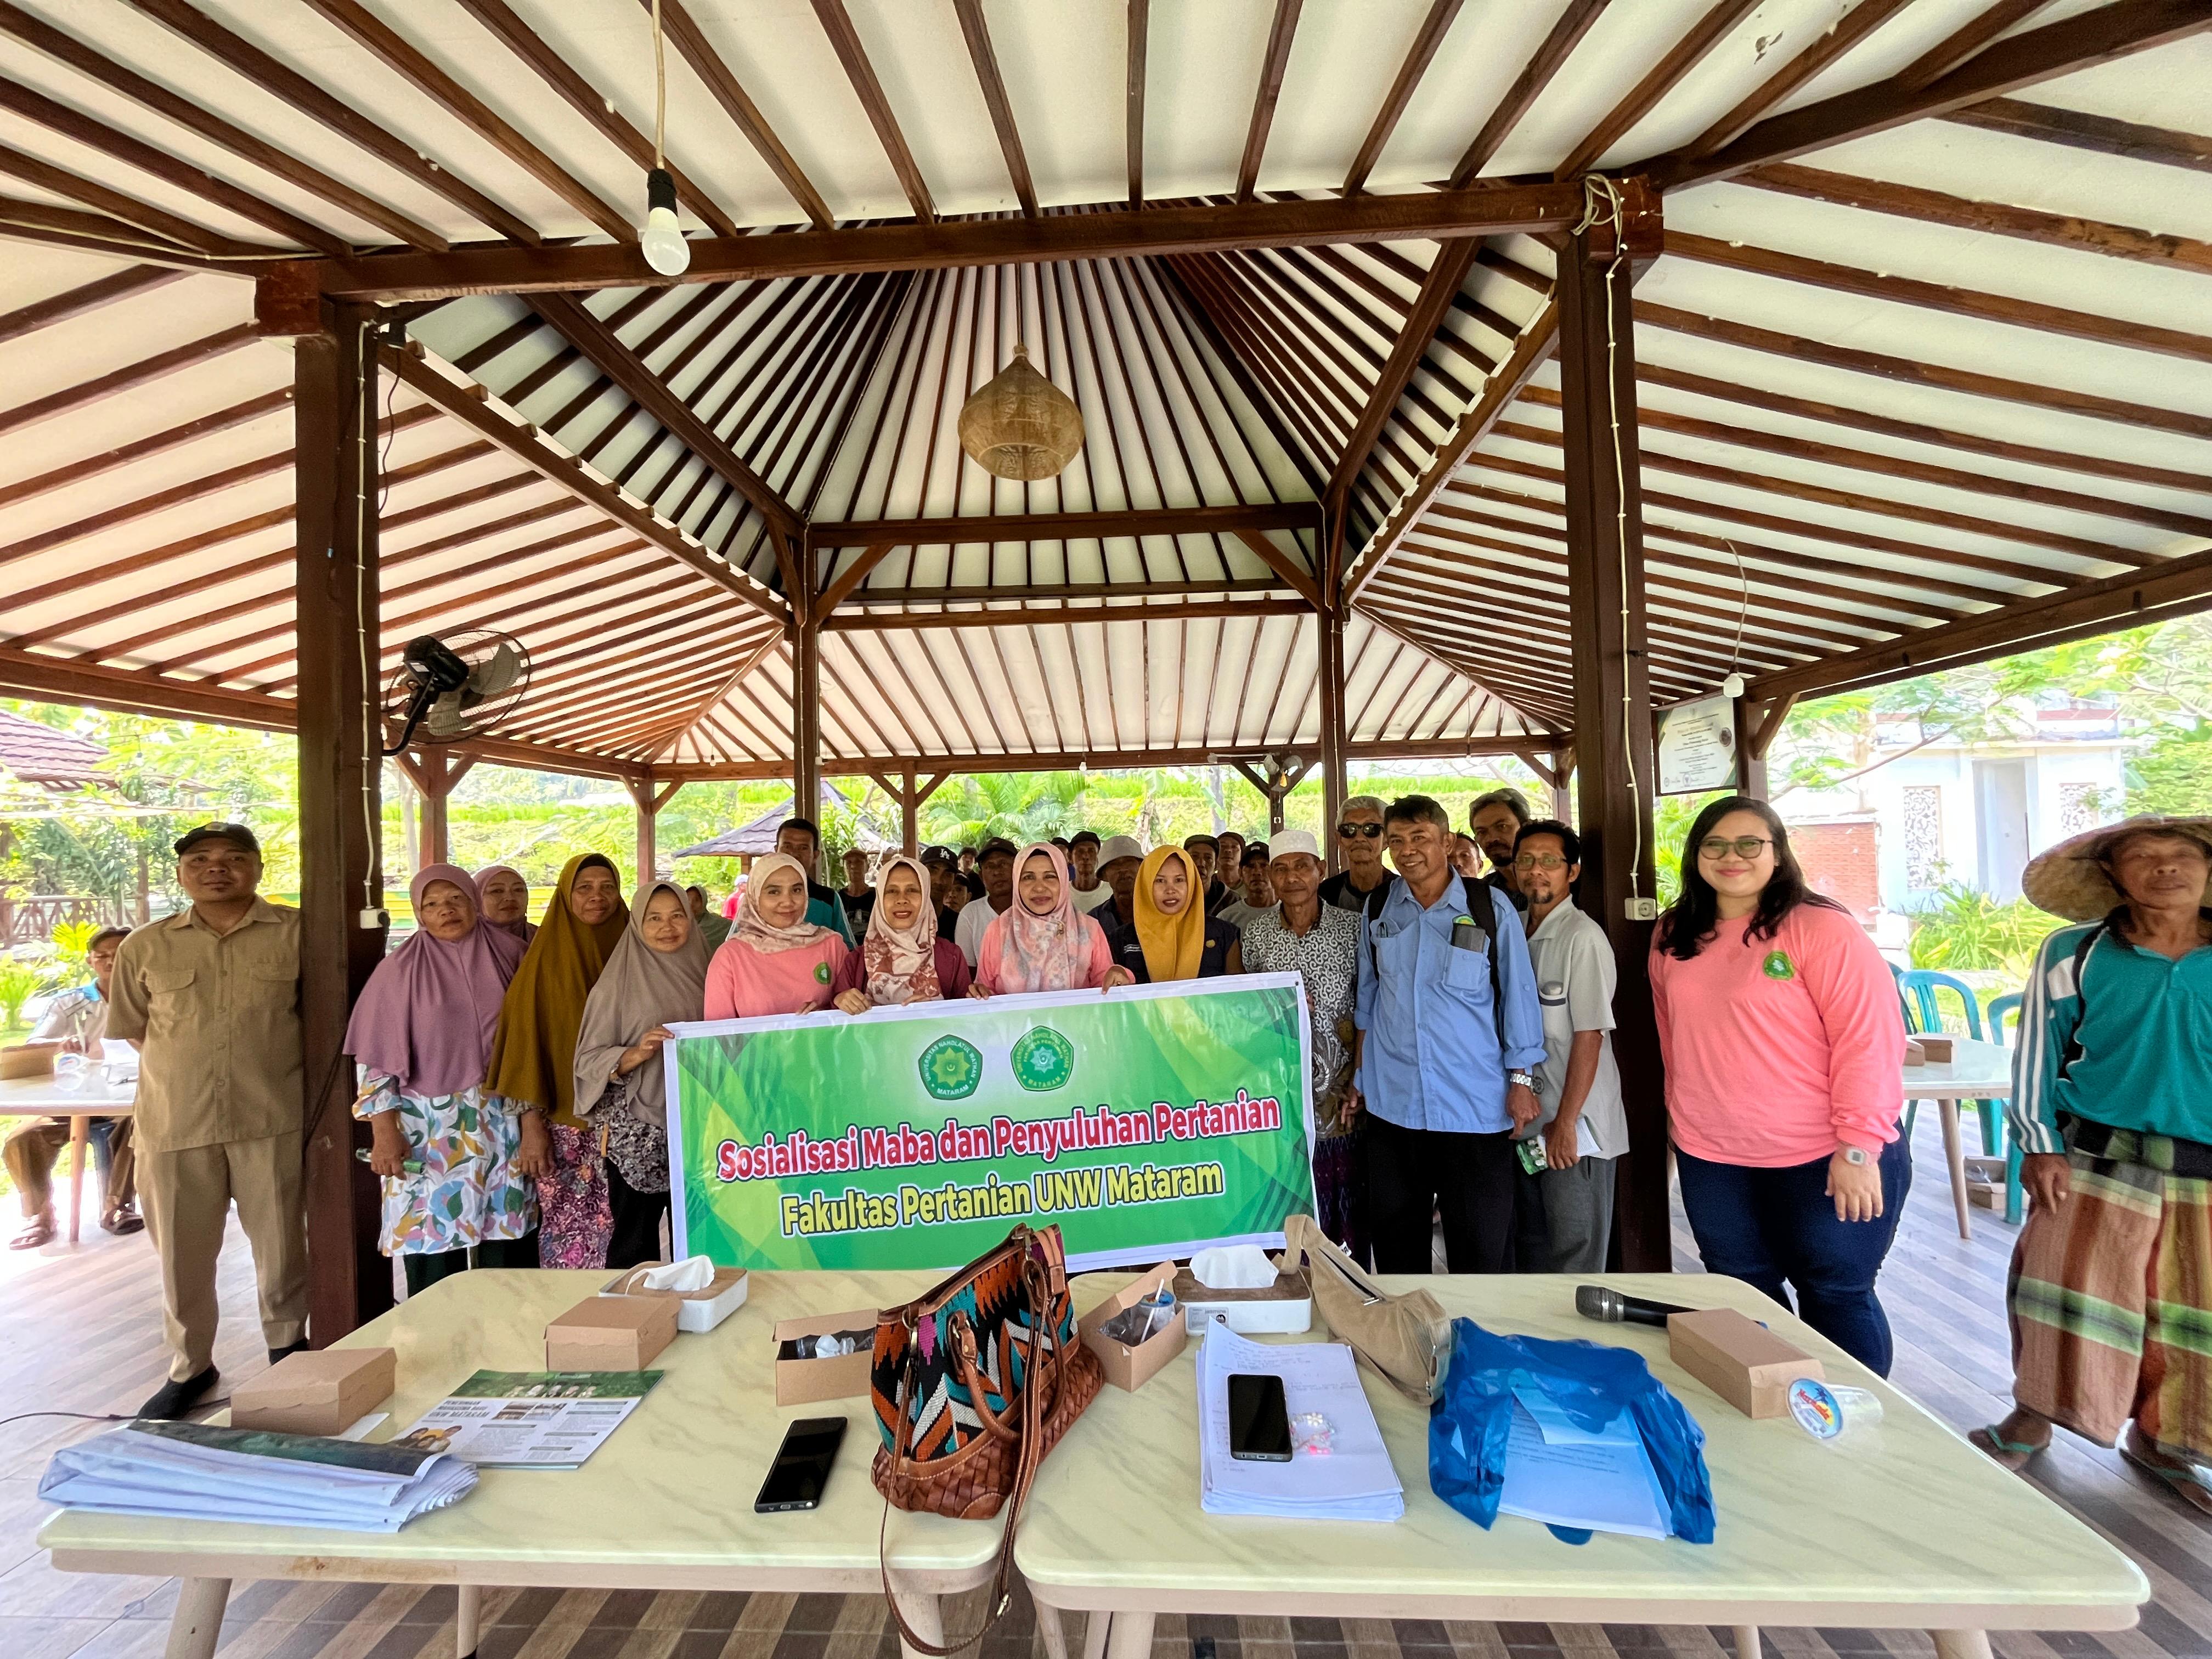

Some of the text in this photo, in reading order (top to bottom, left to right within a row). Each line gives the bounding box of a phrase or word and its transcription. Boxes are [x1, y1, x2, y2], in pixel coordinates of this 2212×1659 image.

[940, 848, 950, 860] LA
[923, 1040, 977, 1081] UNIVERSITAS NAHDLATUL WATHAN
[937, 1084, 969, 1096] MATARAM
[1028, 1076, 1061, 1087] MATARAM
[717, 1088, 1280, 1182] Sosialisasi Maba dan Penyuluhan Pertanian
[781, 1163, 1223, 1235] Fakultas Pertanian UNW Mataram
